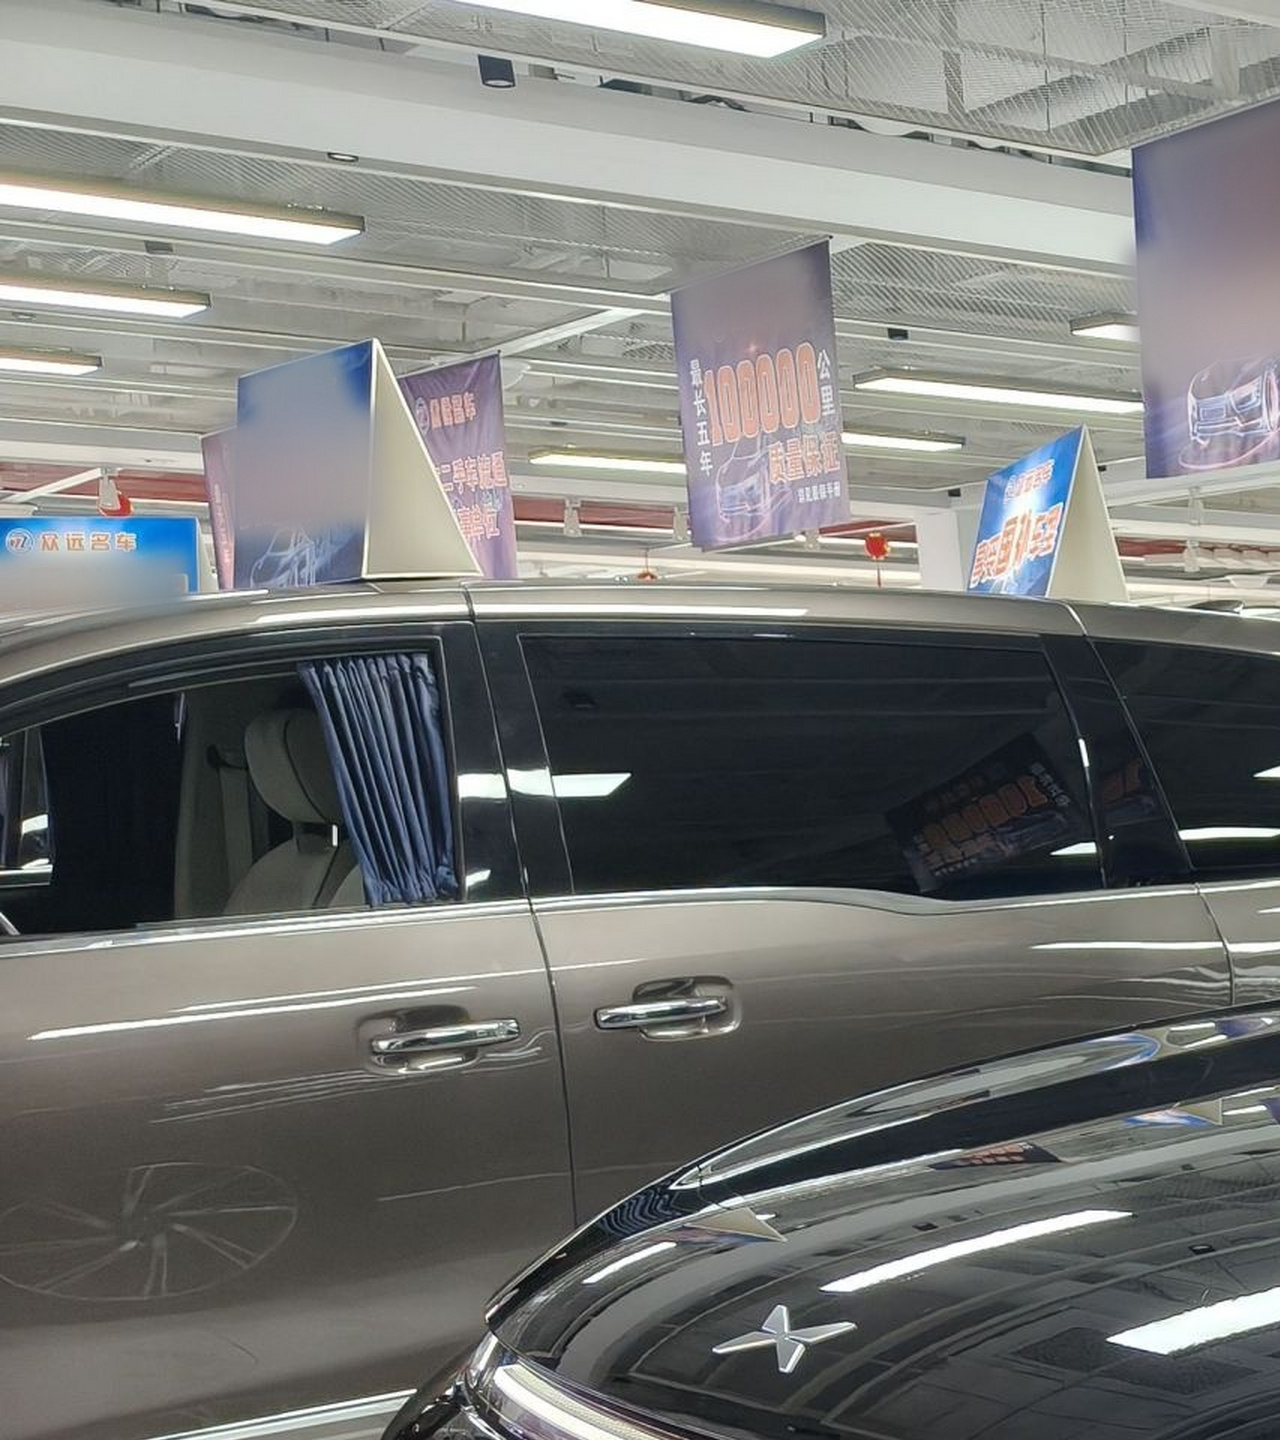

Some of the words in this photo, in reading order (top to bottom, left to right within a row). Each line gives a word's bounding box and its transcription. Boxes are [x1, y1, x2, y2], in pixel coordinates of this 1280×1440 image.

[704, 341, 821, 447] 100000
[817, 349, 836, 416] 公里
[690, 359, 713, 477] 最长五年
[768, 431, 841, 485] 质量保证
[40, 531, 138, 552] 众远名车
